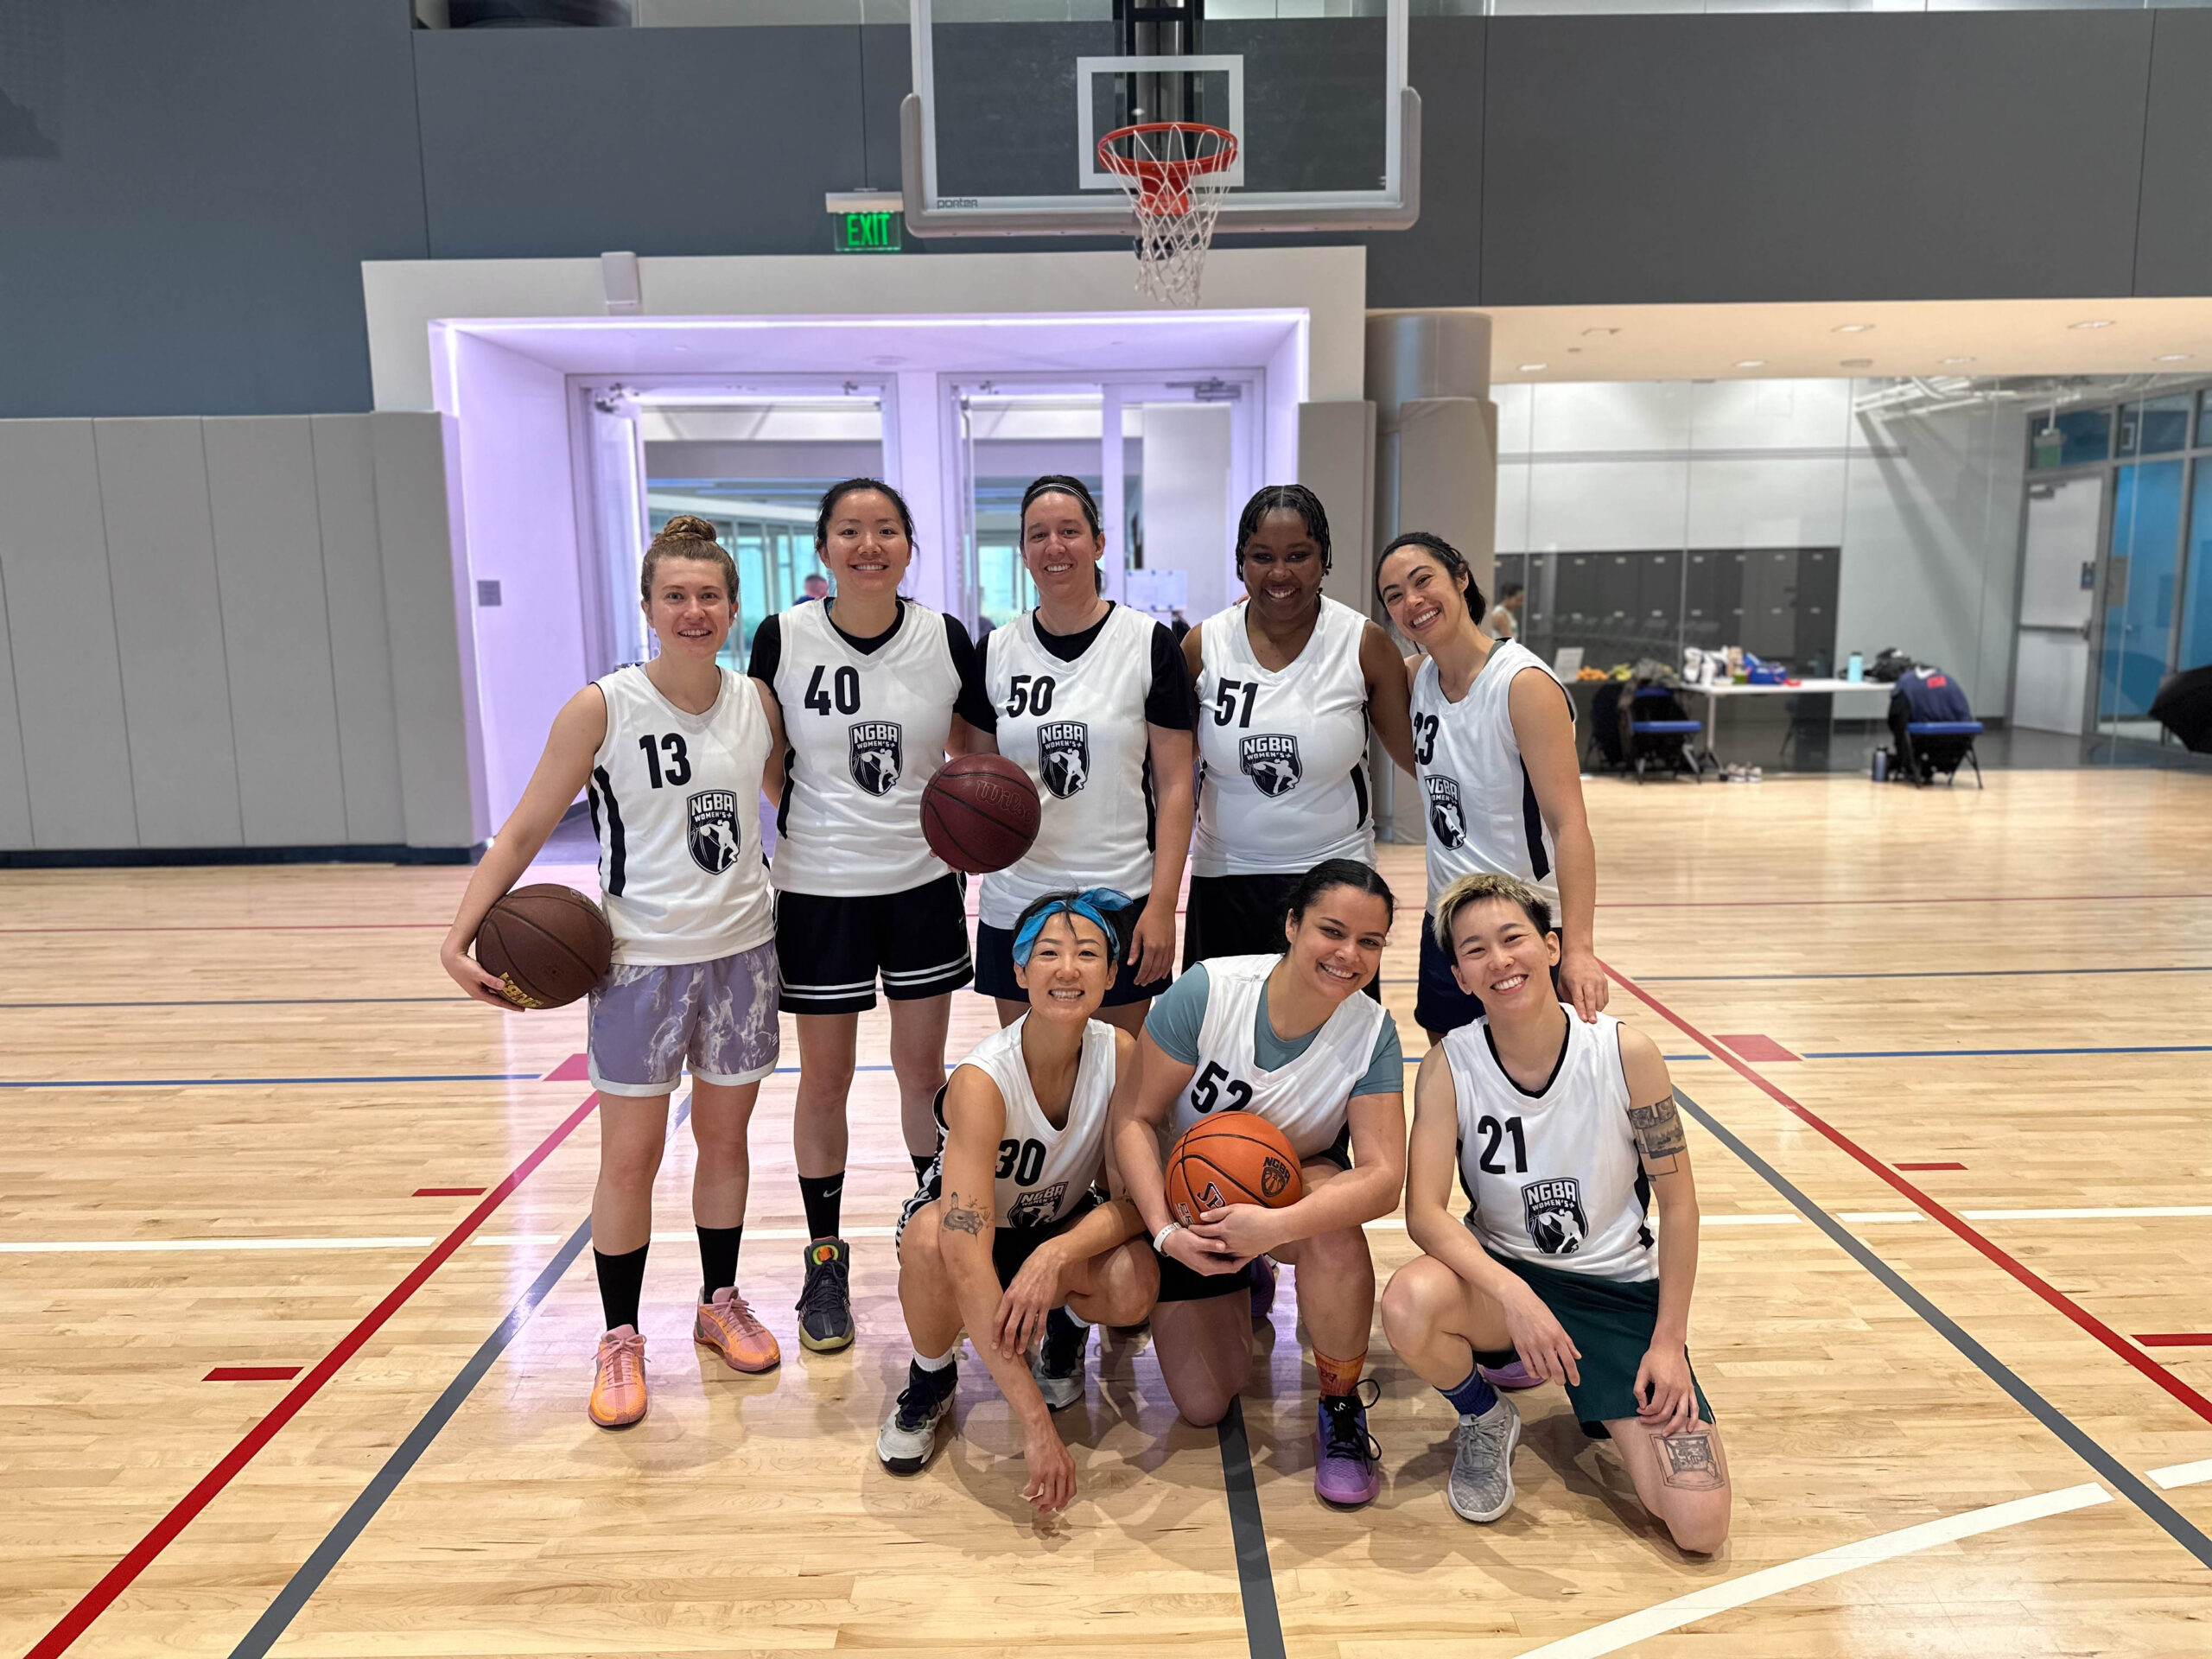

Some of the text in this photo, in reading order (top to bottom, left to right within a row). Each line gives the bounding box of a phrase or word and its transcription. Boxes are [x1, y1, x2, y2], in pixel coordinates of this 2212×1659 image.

[846, 213, 890, 246] EXIT
[804, 665, 861, 715] 40
[1006, 675, 1056, 718] 50
[1214, 677, 1259, 728] 51
[853, 724, 898, 744] NGBA
[1041, 724, 1084, 744] NGBA
[1244, 737, 1294, 756] NGBA
[1414, 711, 1439, 766] 23
[639, 732, 692, 789] 13
[691, 793, 734, 816] NGBA
[1191, 1060, 1253, 1113] 52
[995, 1137, 1046, 1187] 30
[1478, 1115, 1528, 1174] 21
[1263, 1156, 1290, 1185] NGBA
[1020, 1185, 1065, 1205] NGBA
[1526, 1181, 1577, 1205] NGBA
